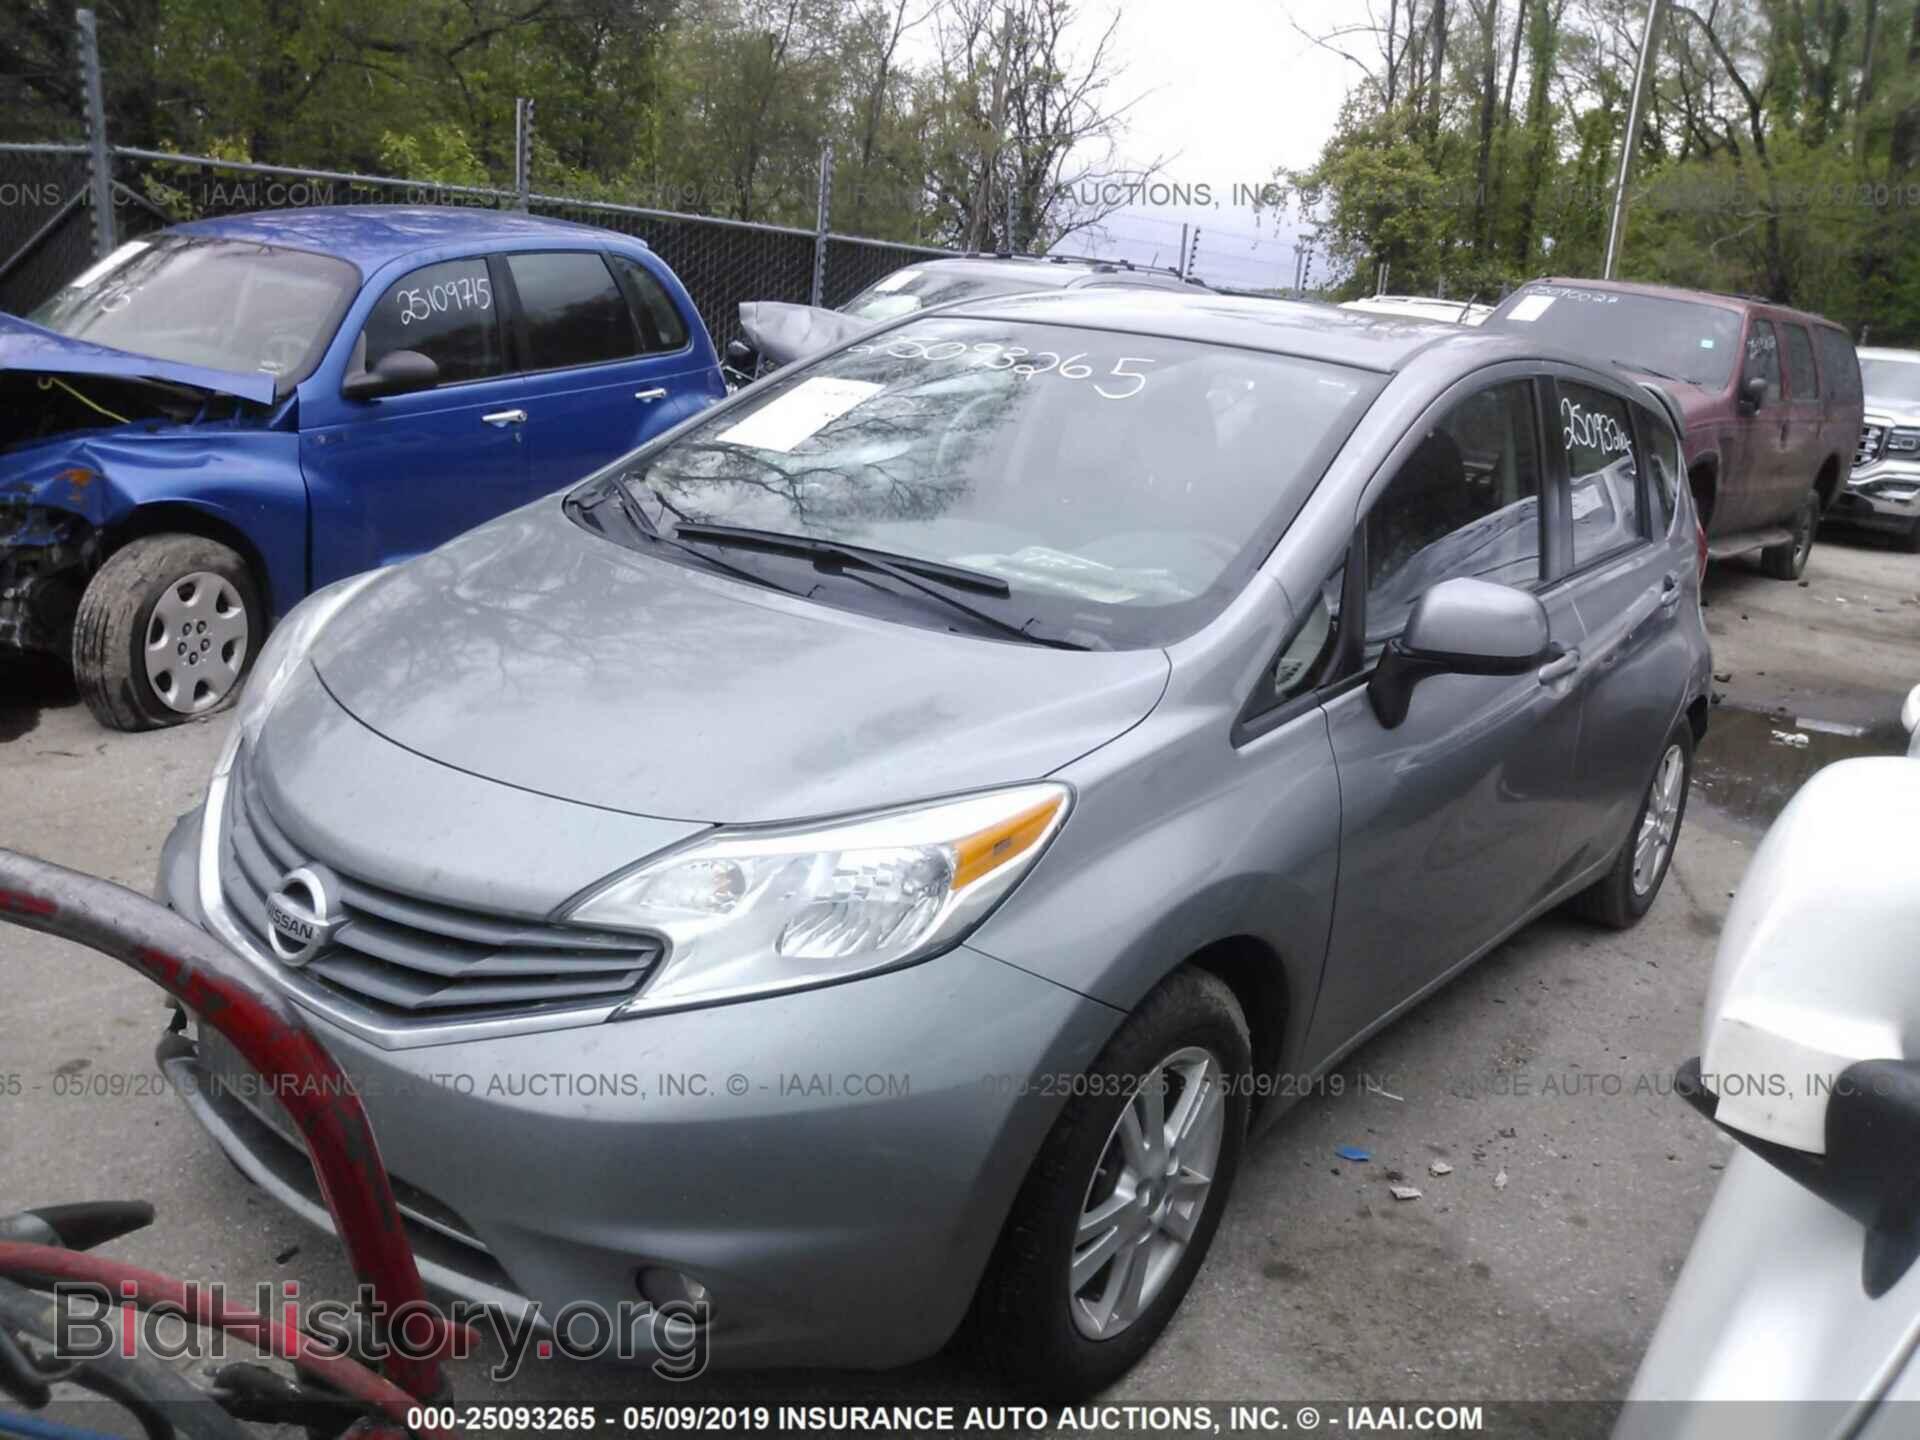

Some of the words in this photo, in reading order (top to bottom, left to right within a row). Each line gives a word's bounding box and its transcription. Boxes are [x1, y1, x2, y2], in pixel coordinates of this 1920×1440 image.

[396, 277, 491, 325] 25109715
[848, 337, 1156, 399] 25093265
[266, 900, 314, 940] NISSAN
